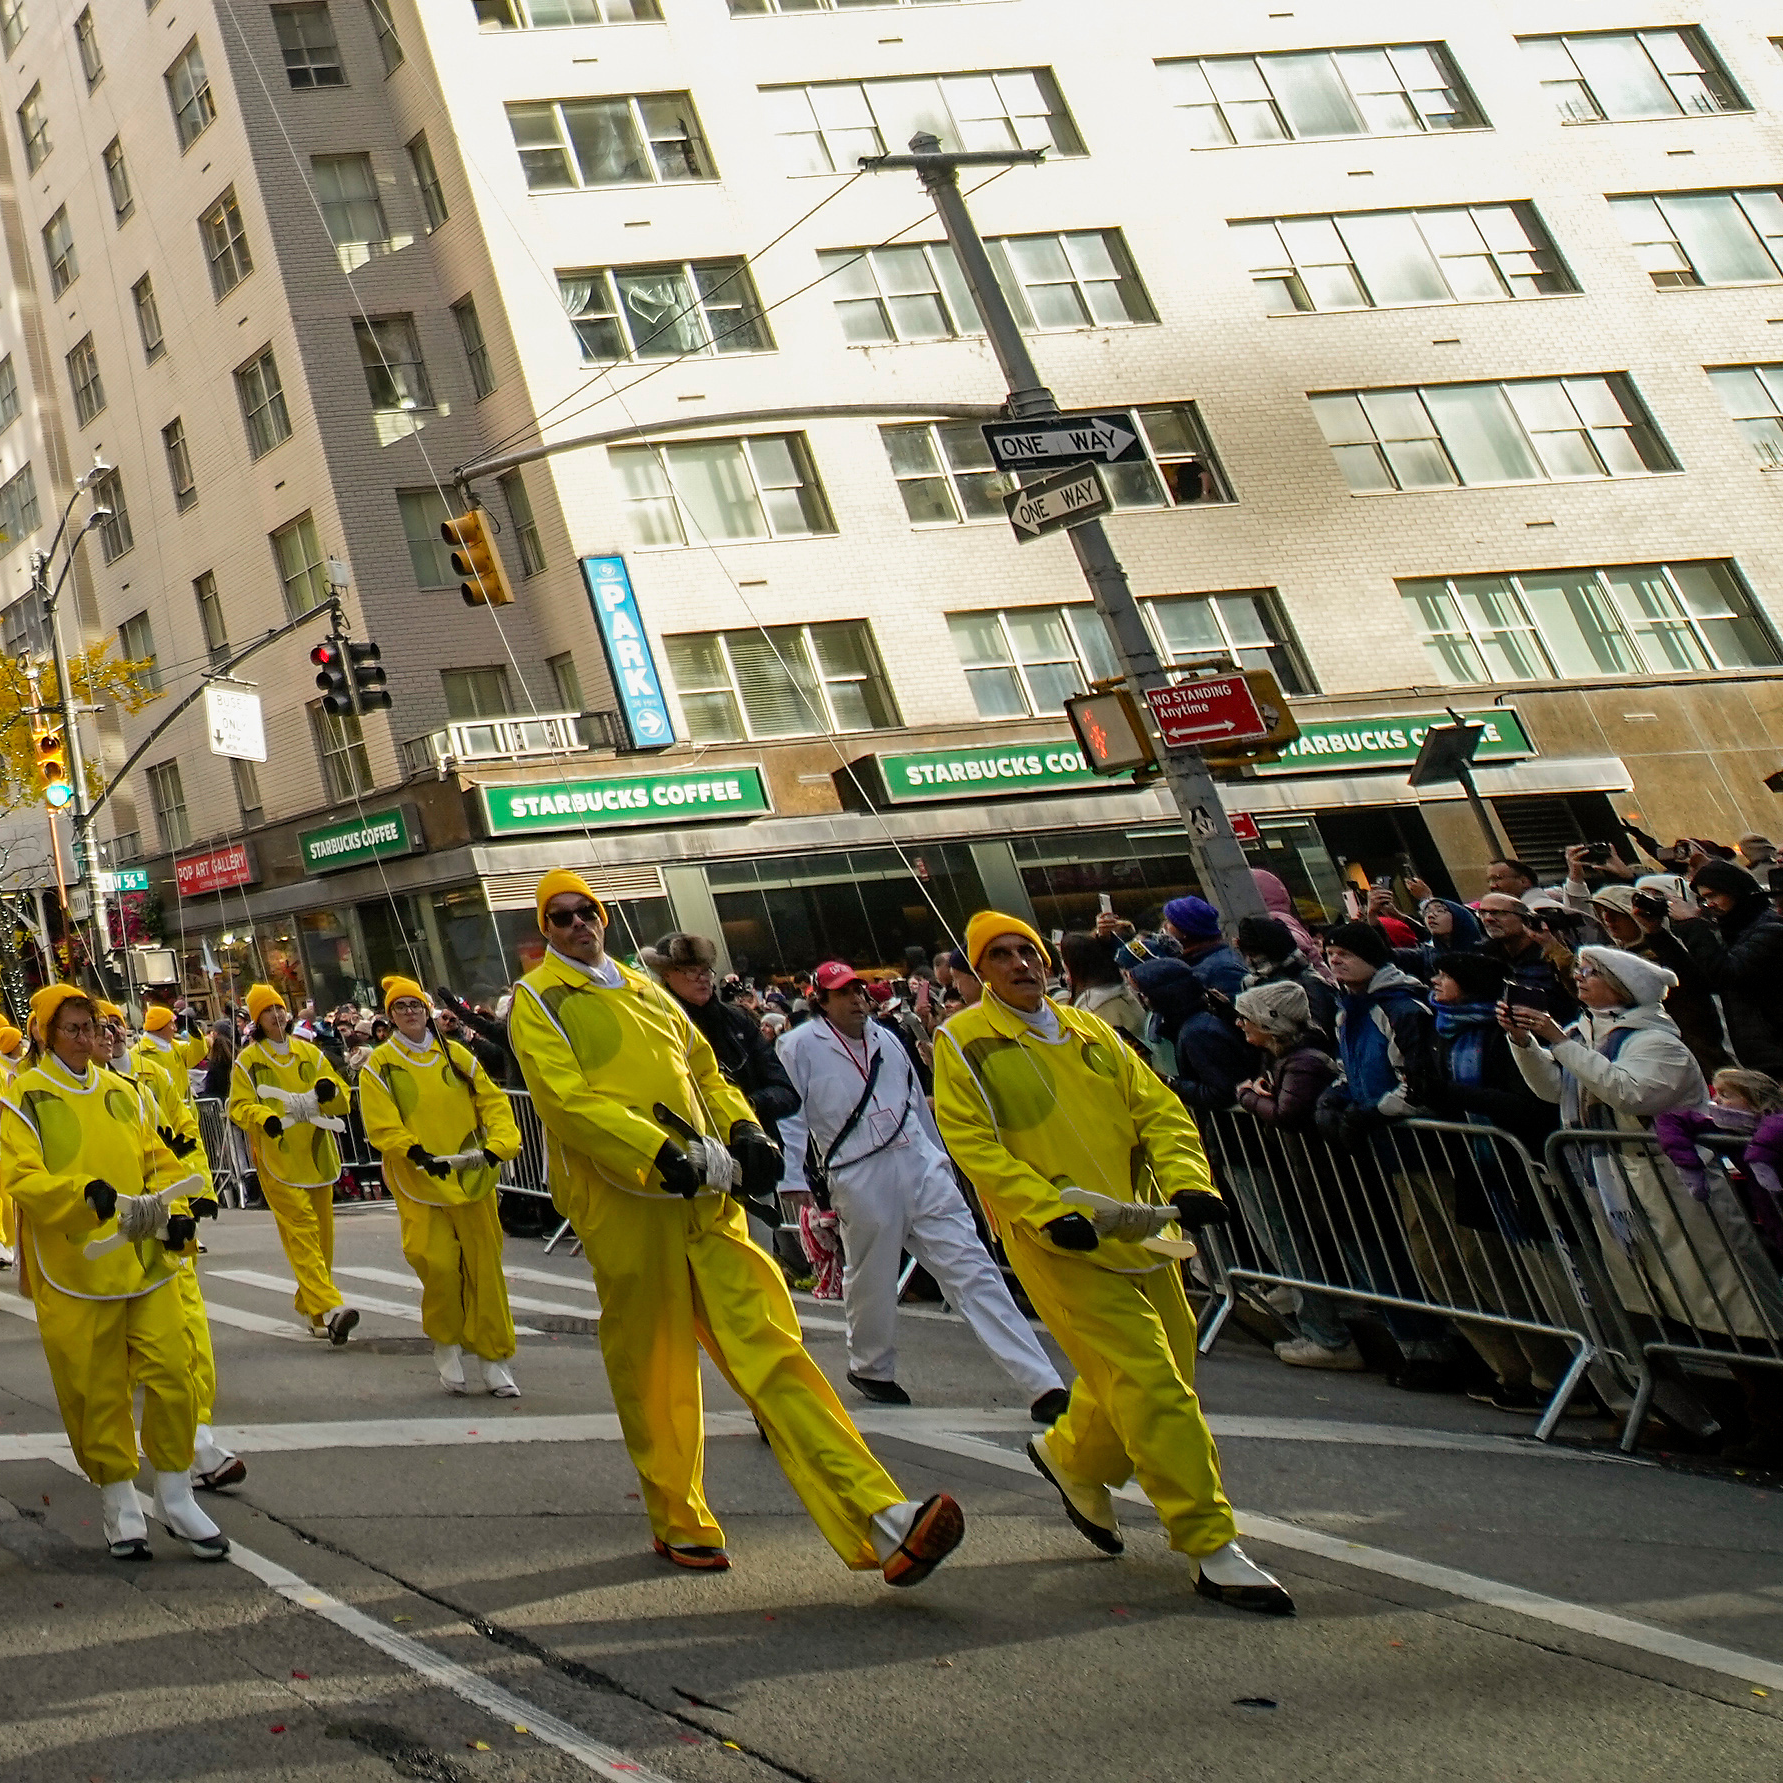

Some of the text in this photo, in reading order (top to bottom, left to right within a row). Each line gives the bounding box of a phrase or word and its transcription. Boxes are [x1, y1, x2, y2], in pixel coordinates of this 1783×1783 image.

[1001, 429, 1115, 456] ONE WAY
[1019, 480, 1095, 524] ONE WAY
[599, 584, 656, 697] PARK
[1152, 684, 1232, 707] NO STANDING
[1160, 702, 1210, 719] Anytime
[906, 755, 1043, 786] STARBUCKS
[510, 780, 742, 817] STARBUCKS COFFEE
[309, 822, 399, 859] STARBUCKS COFFEE
[123, 874, 136, 888] 56
[178, 865, 193, 883] POP
[196, 860, 210, 878] ART
[211, 852, 245, 874] GALLERY
